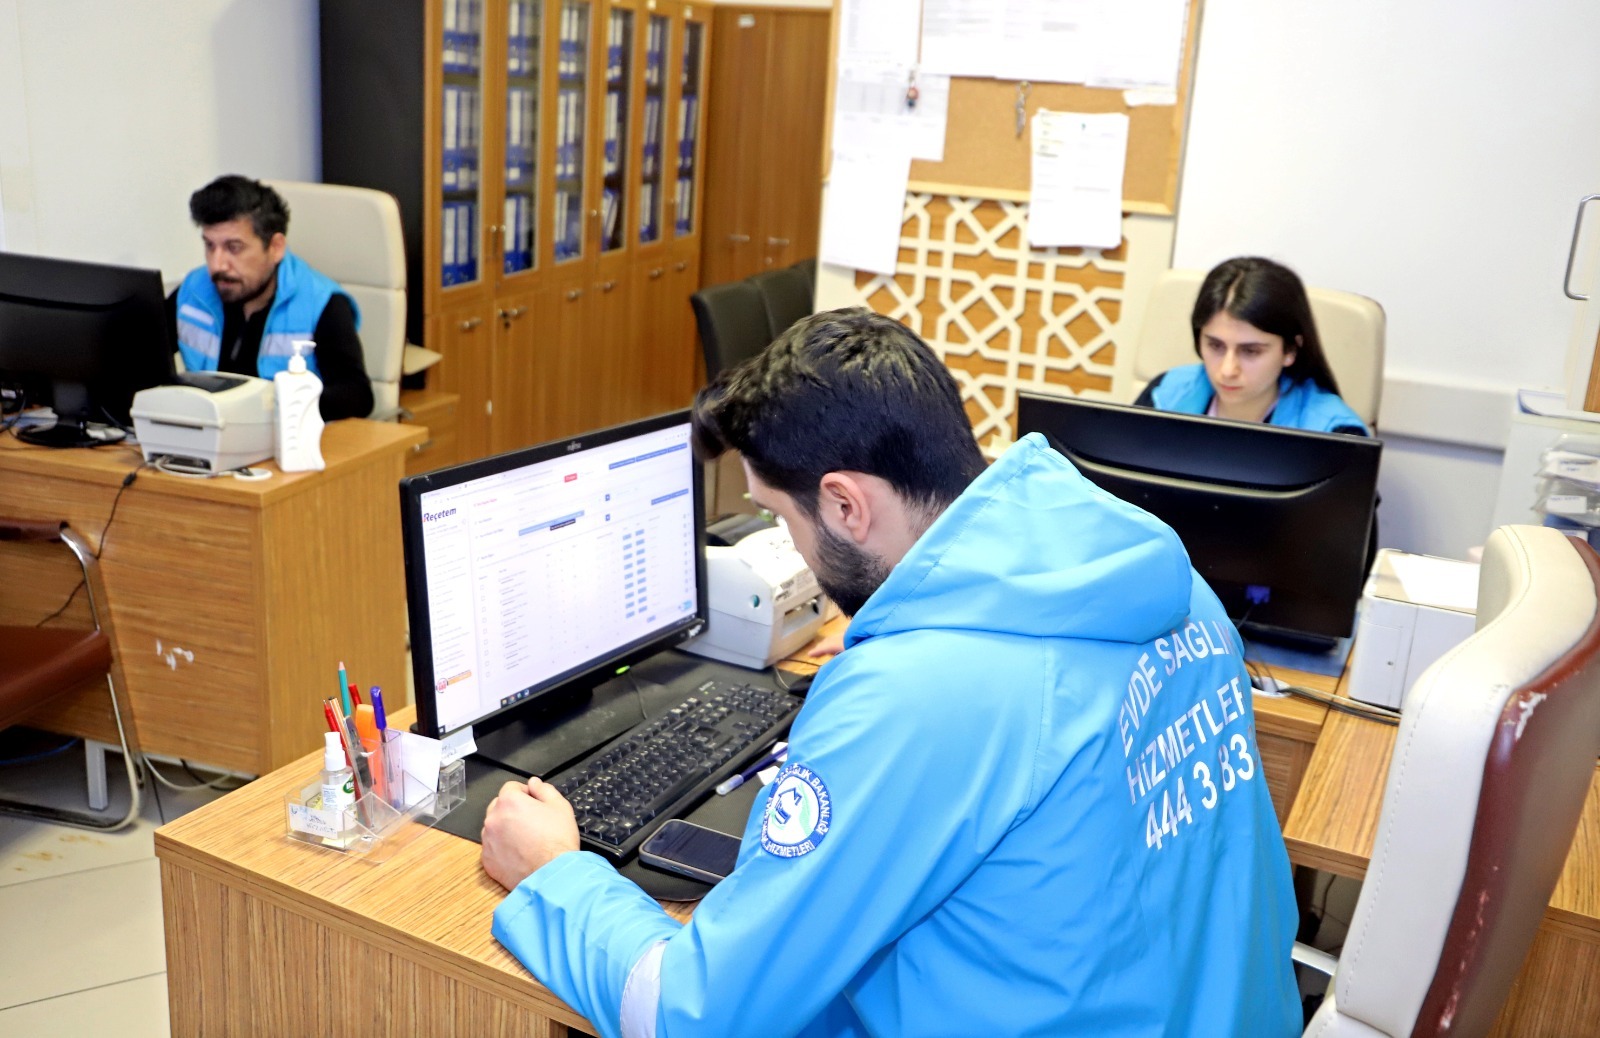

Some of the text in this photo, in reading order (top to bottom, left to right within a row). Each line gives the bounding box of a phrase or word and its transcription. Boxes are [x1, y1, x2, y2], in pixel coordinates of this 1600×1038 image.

[422, 508, 457, 522] Reçetem
[1118, 652, 1163, 758] EVDE
[1146, 728, 1257, 850] 444 3 83
